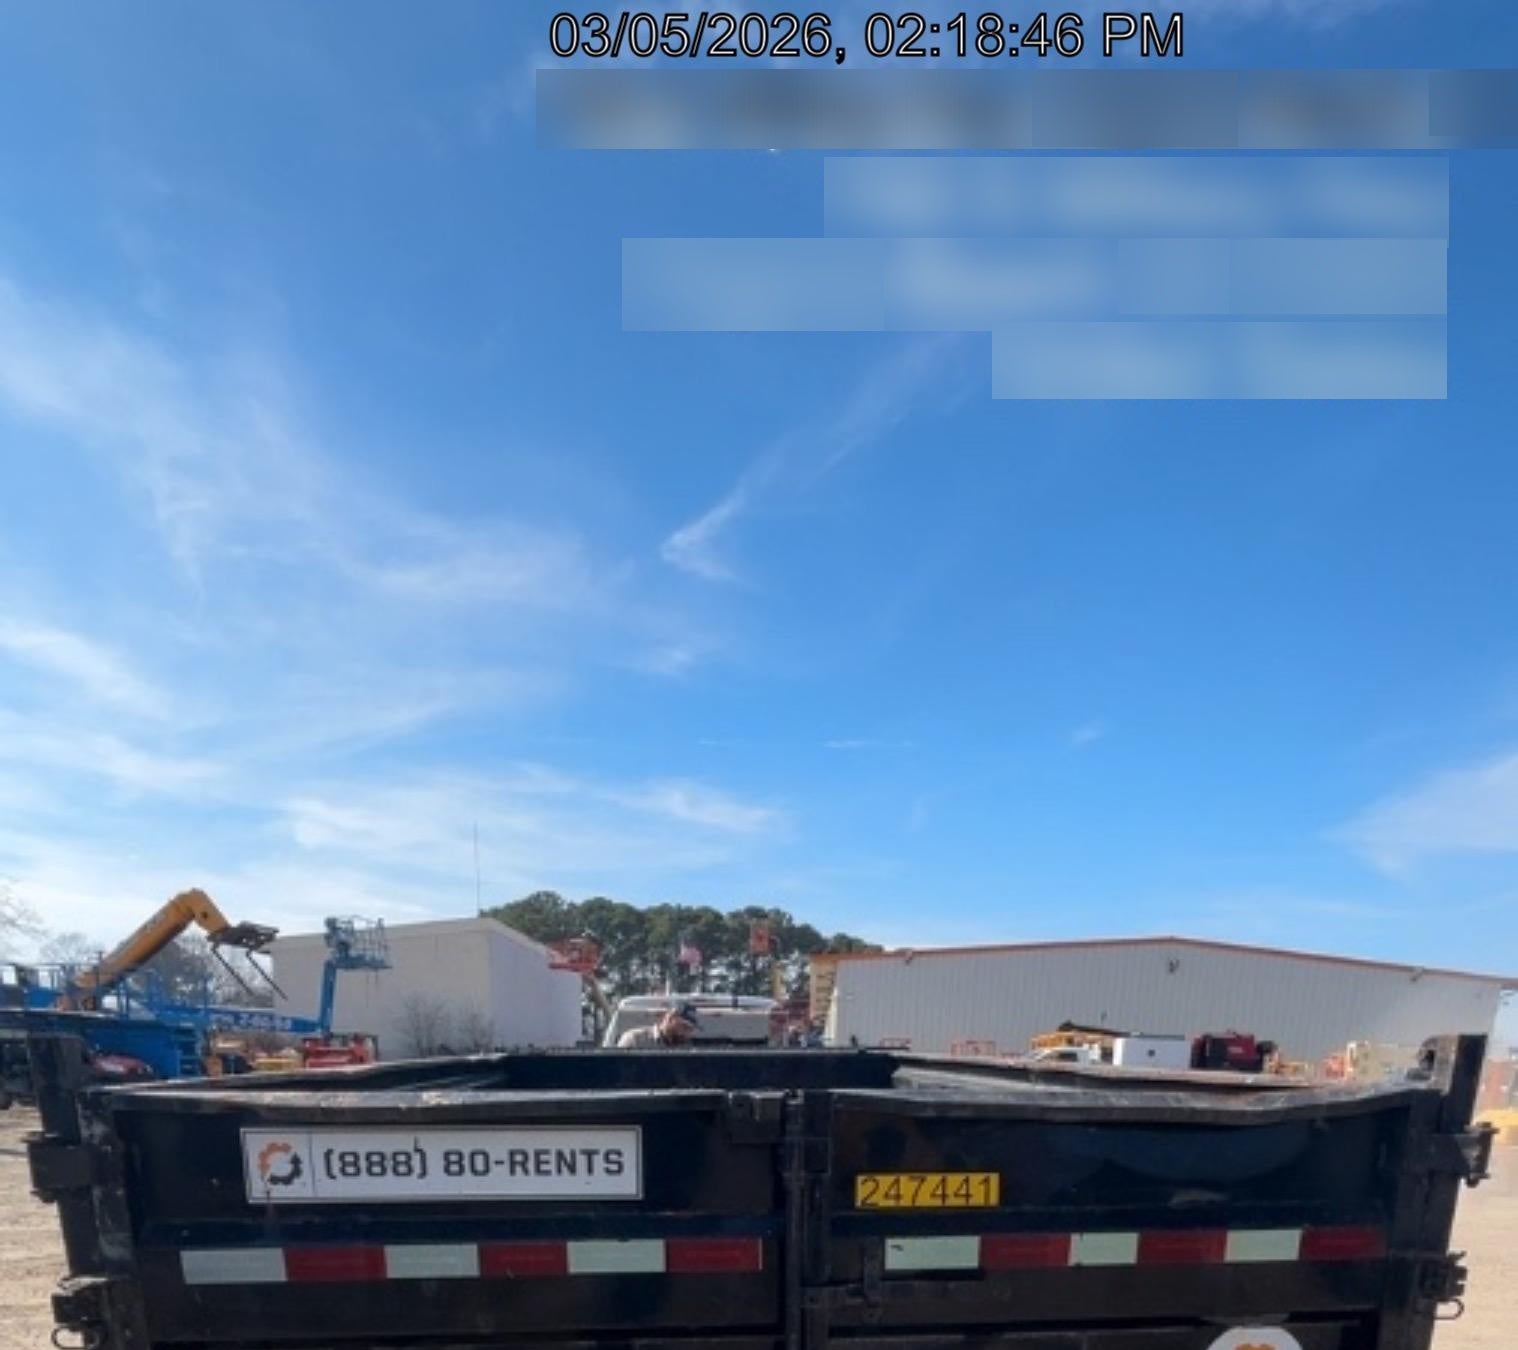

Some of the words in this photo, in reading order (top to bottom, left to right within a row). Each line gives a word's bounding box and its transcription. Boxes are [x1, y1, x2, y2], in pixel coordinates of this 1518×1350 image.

[323, 1147, 428, 1180] (888)
[442, 1148, 624, 1177] 80-RENTS
[860, 1174, 992, 1207] 247441
